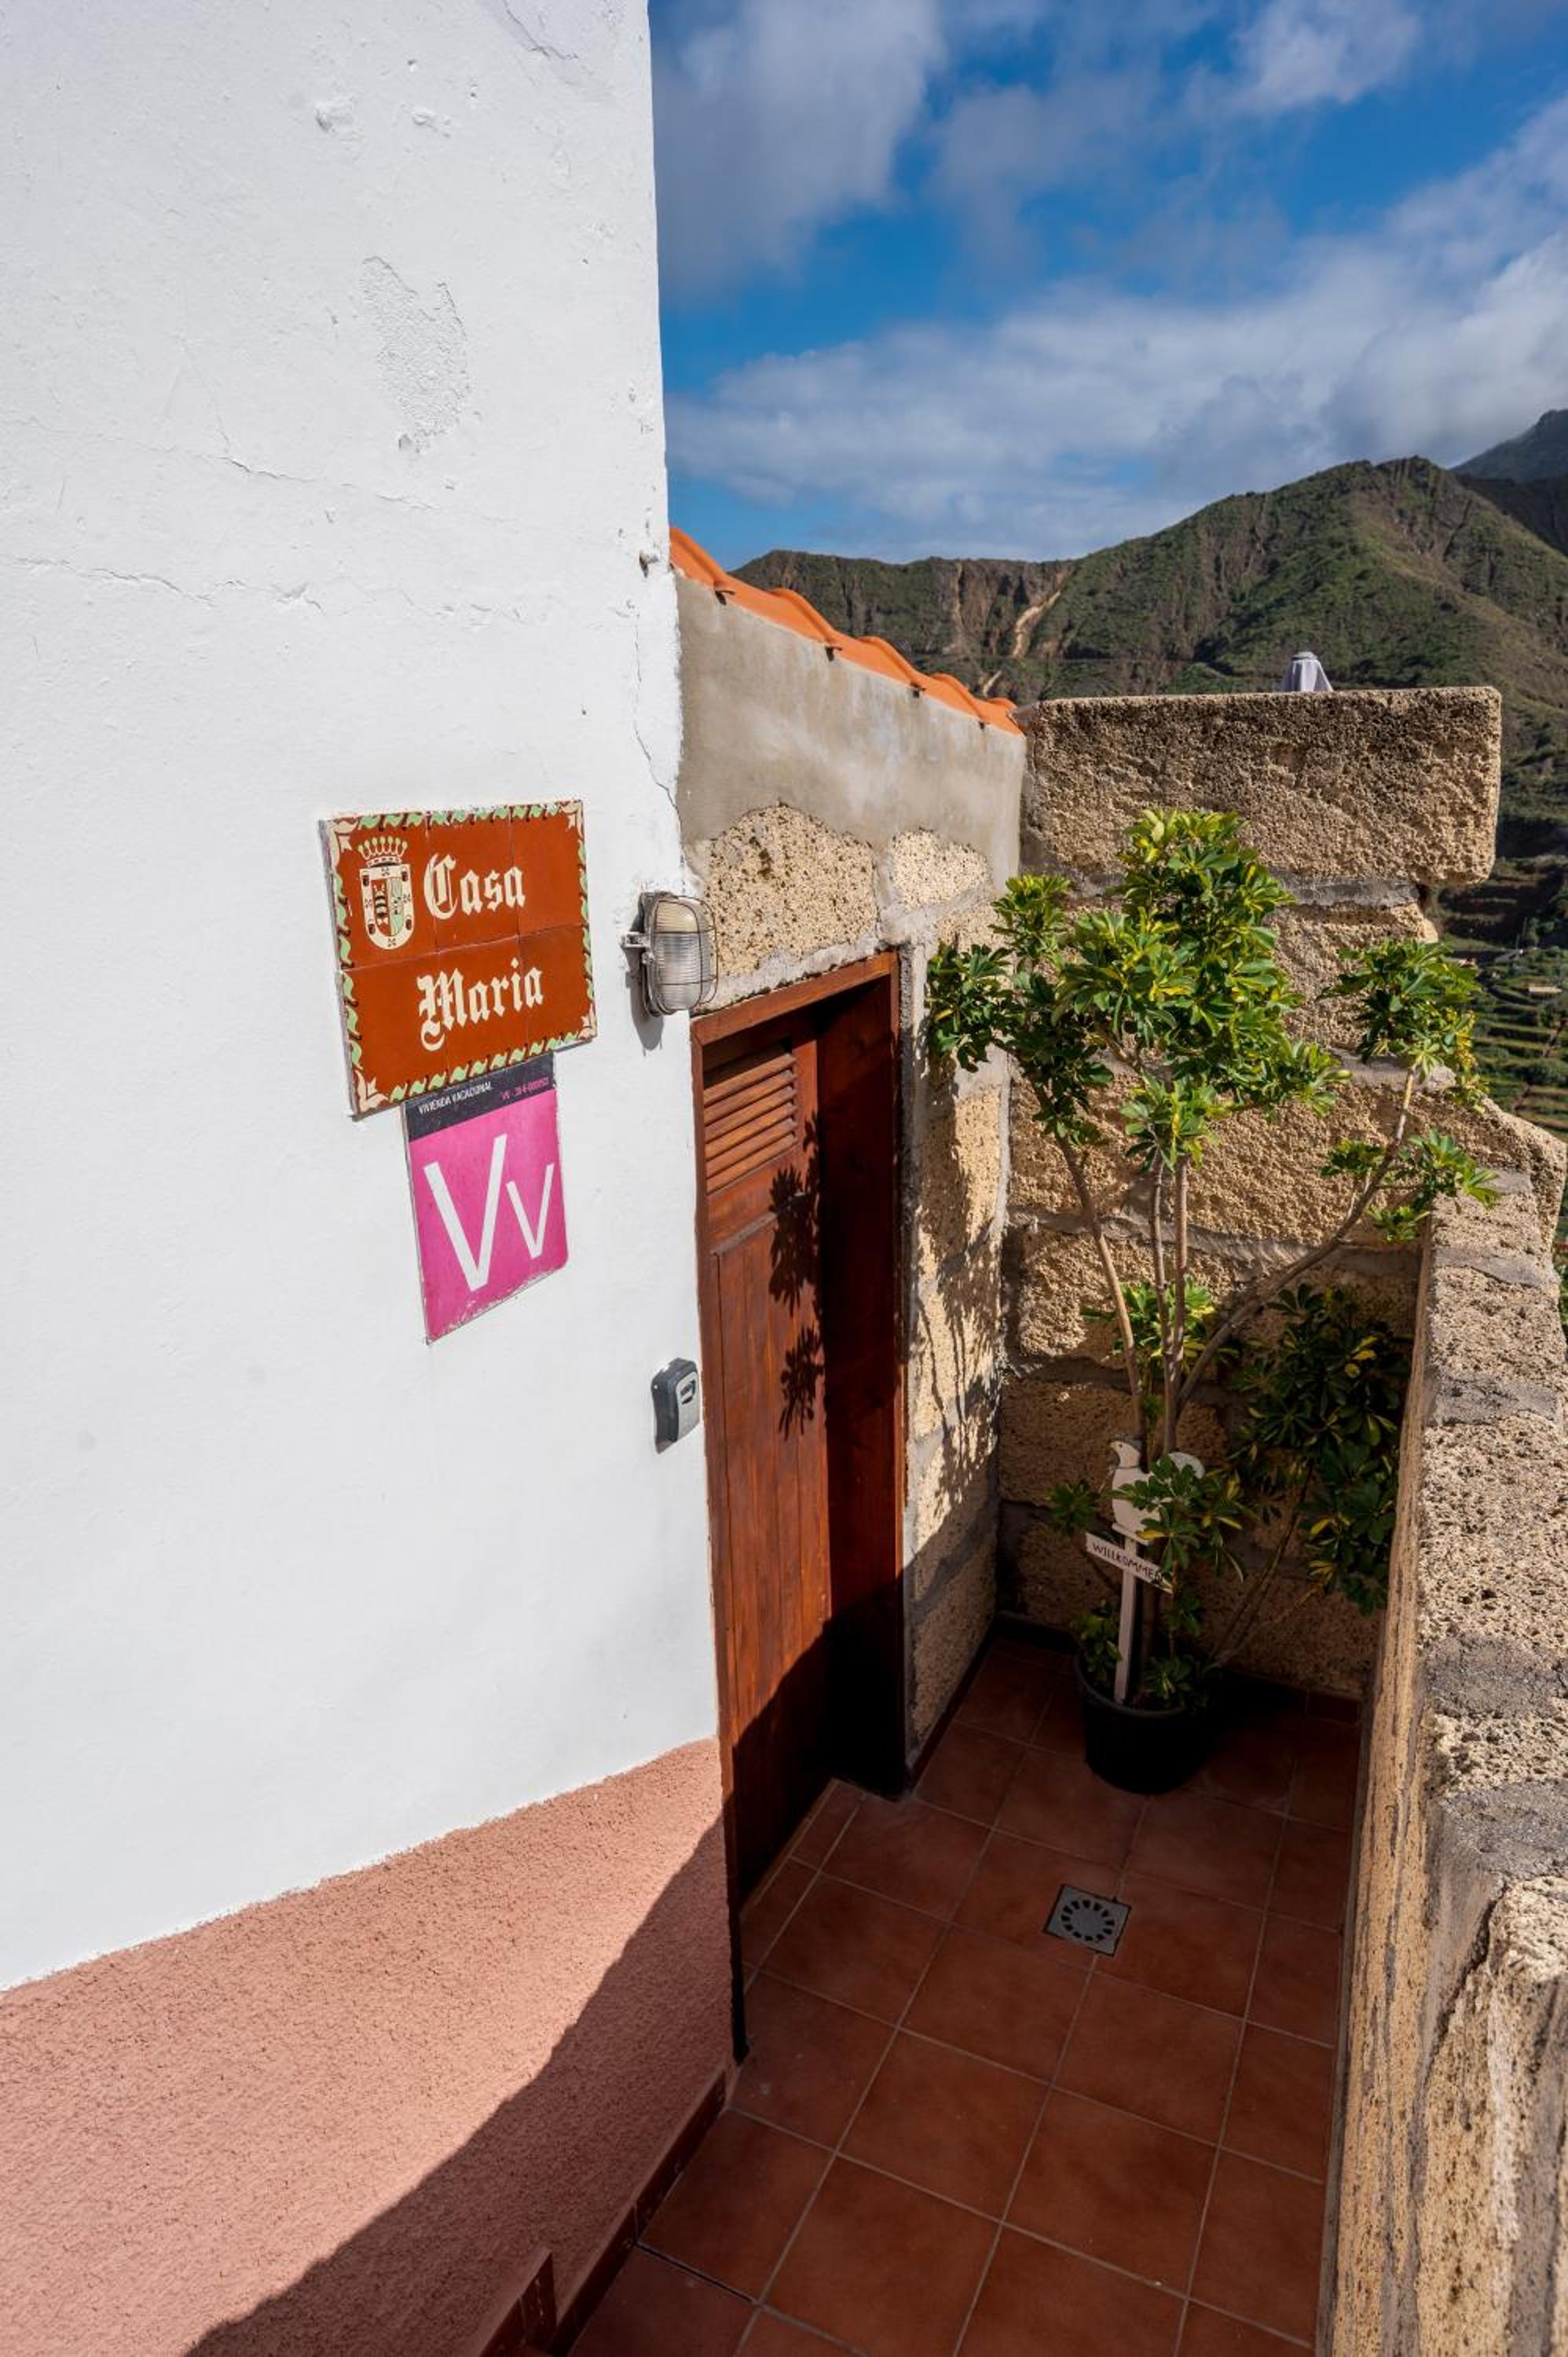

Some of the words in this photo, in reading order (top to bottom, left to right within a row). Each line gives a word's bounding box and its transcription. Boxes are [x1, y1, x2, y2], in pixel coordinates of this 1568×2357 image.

[423, 852, 526, 919] Casa
[416, 957, 544, 1052] Maria
[417, 1097, 452, 1116] VIVIENDA
[452, 1080, 493, 1104] VACACIONAL
